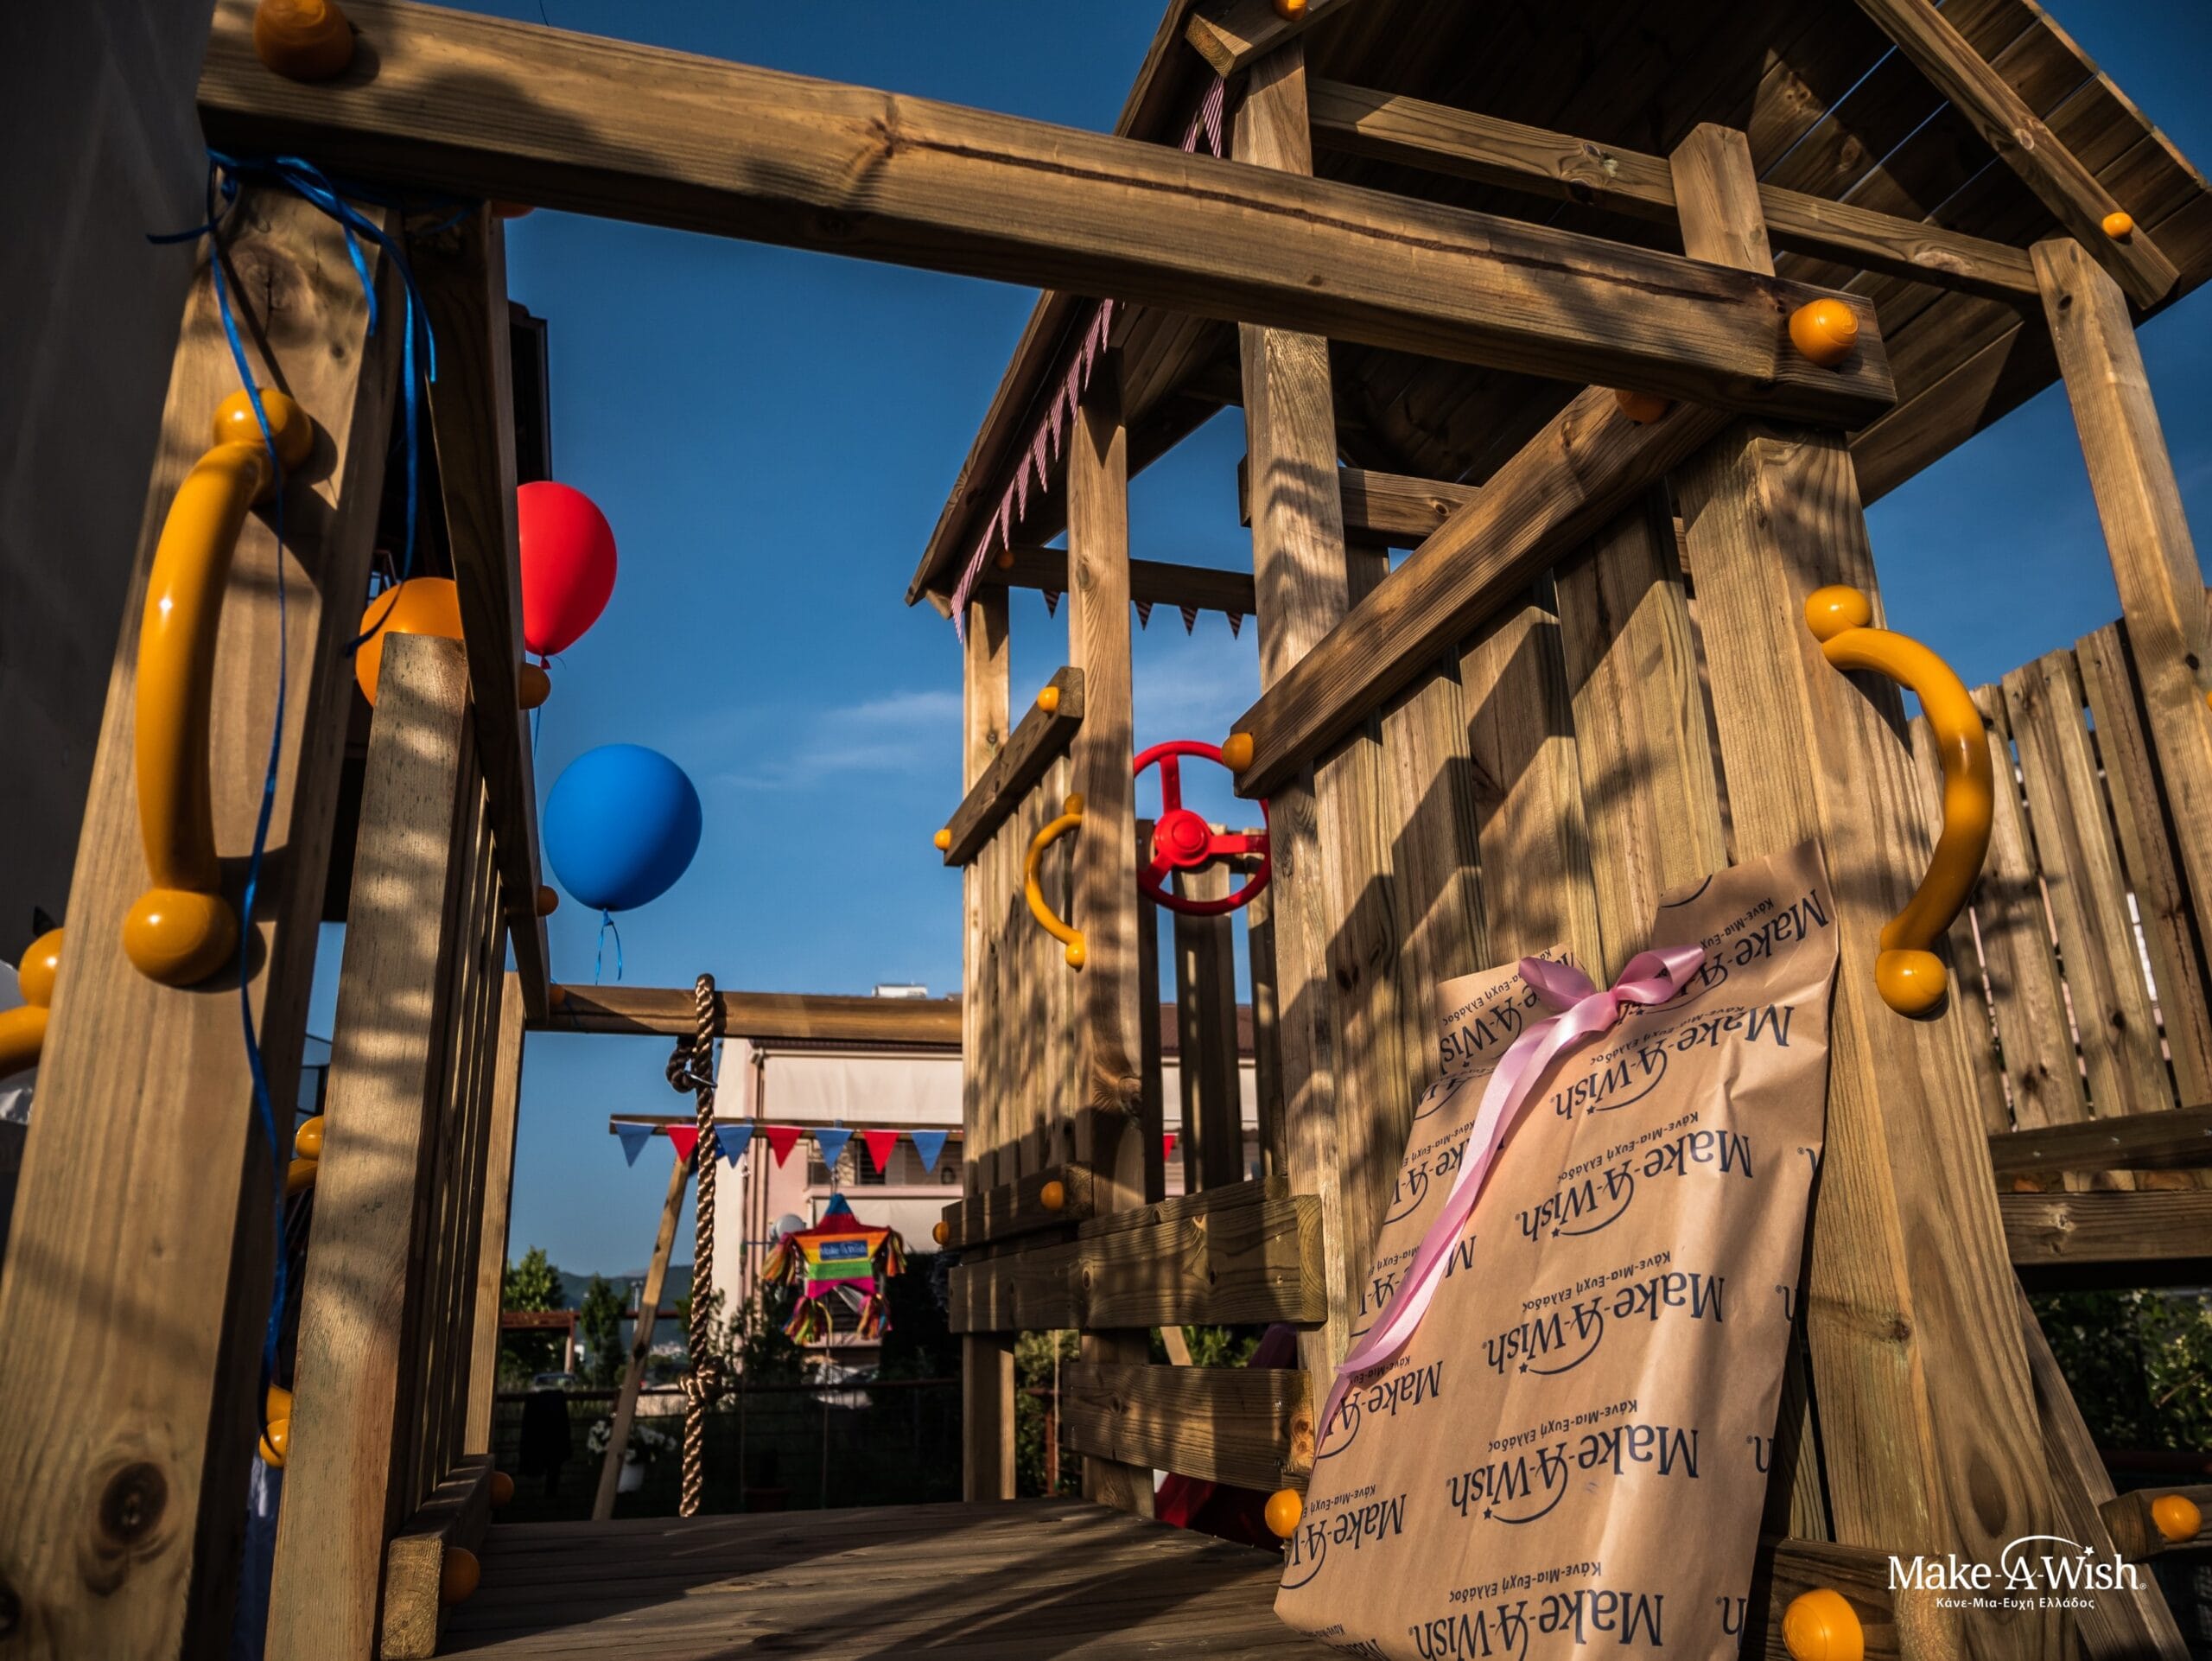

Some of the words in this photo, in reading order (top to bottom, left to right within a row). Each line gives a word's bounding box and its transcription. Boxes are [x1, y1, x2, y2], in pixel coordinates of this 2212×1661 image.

[1700, 898, 1774, 950] Κάνε-Μια-Ευχ
[1521, 1130, 1753, 1242] Make-A-Wish
[1488, 1272, 1726, 1376] Make-A-Wish
[1452, 1424, 1700, 1524] Make-A-Wish
